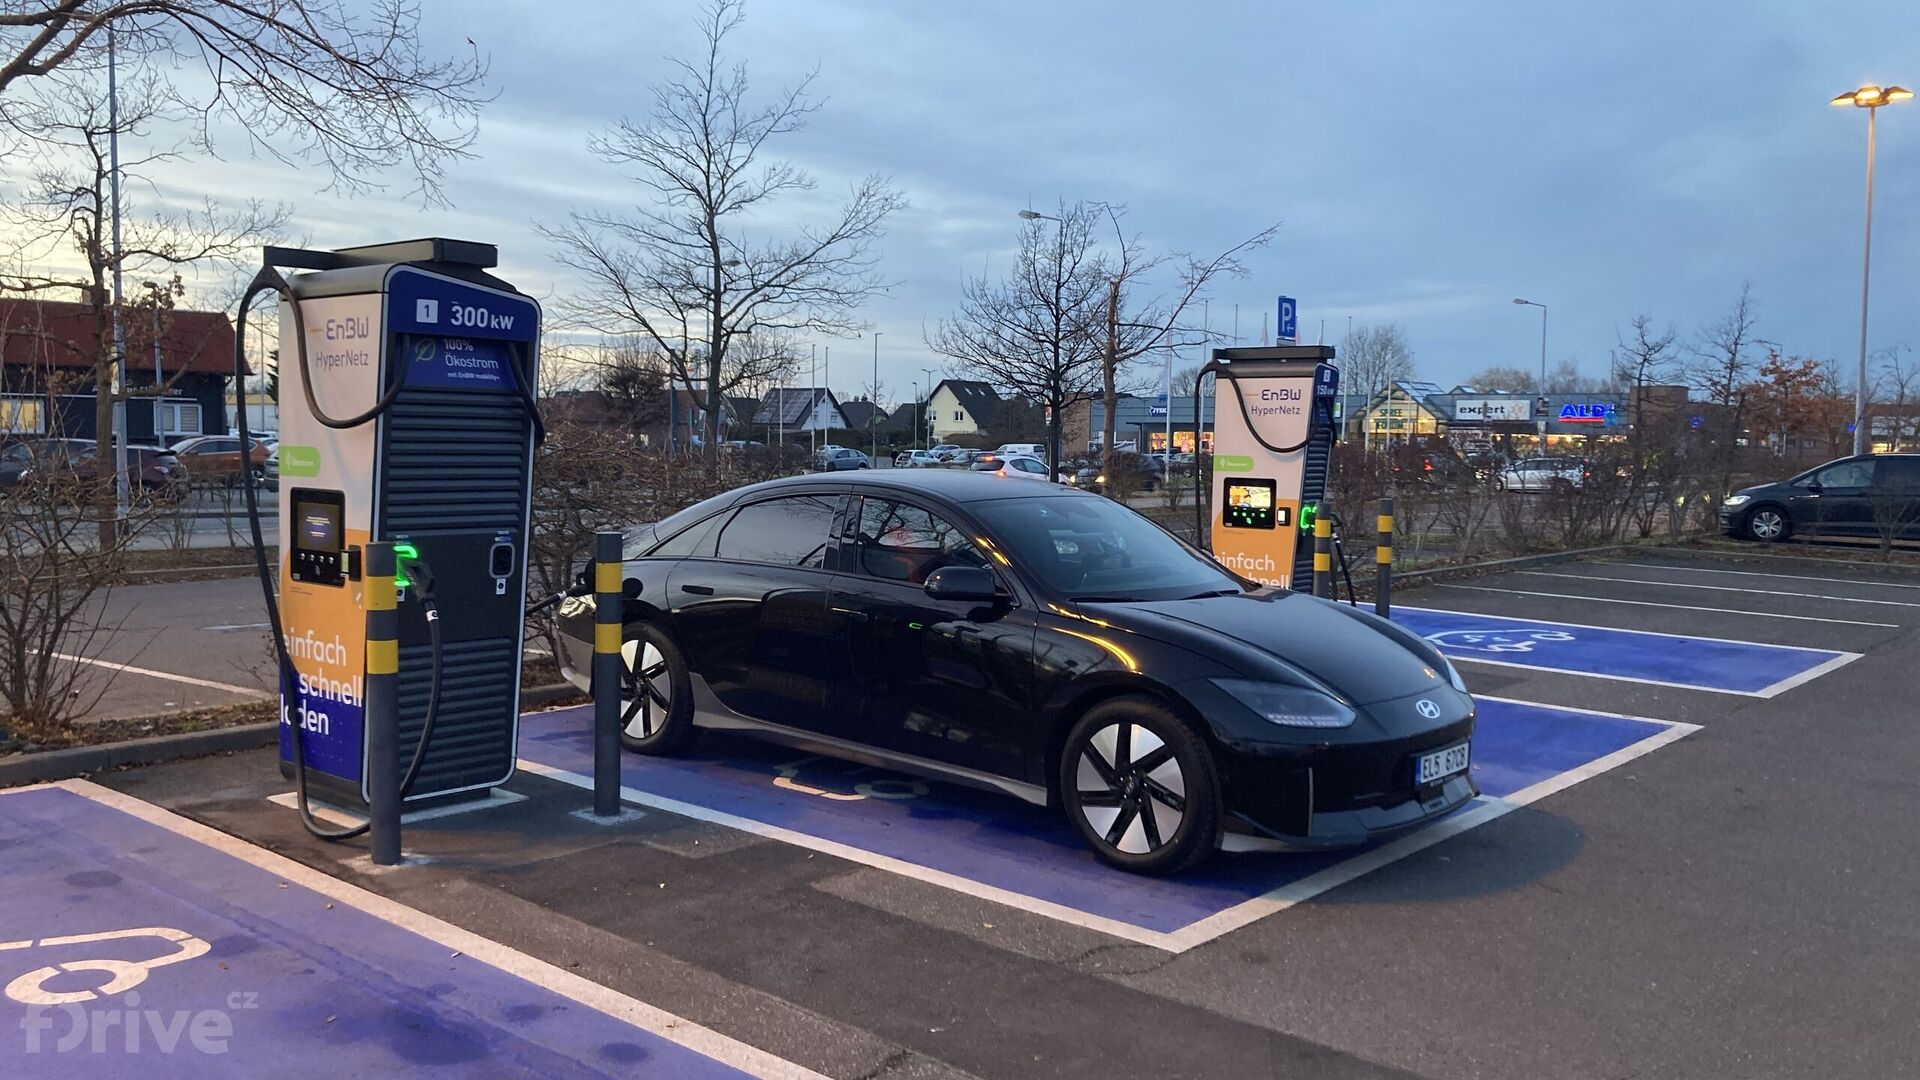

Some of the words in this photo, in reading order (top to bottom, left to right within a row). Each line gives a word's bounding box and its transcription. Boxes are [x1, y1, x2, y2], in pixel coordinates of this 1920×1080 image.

[424, 304, 430, 318] 1
[450, 304, 488, 328] 300
[490, 314, 514, 330] kW
[1282, 302, 1292, 332] P
[325, 316, 369, 340] EnBW
[443, 338, 474, 352] 100%
[315, 350, 369, 371] HyperNetz
[445, 351, 499, 369] Ökostrom
[1261, 389, 1302, 401] EnBW
[1250, 405, 1301, 416] HyperNetz
[299, 667, 362, 708] schnell
